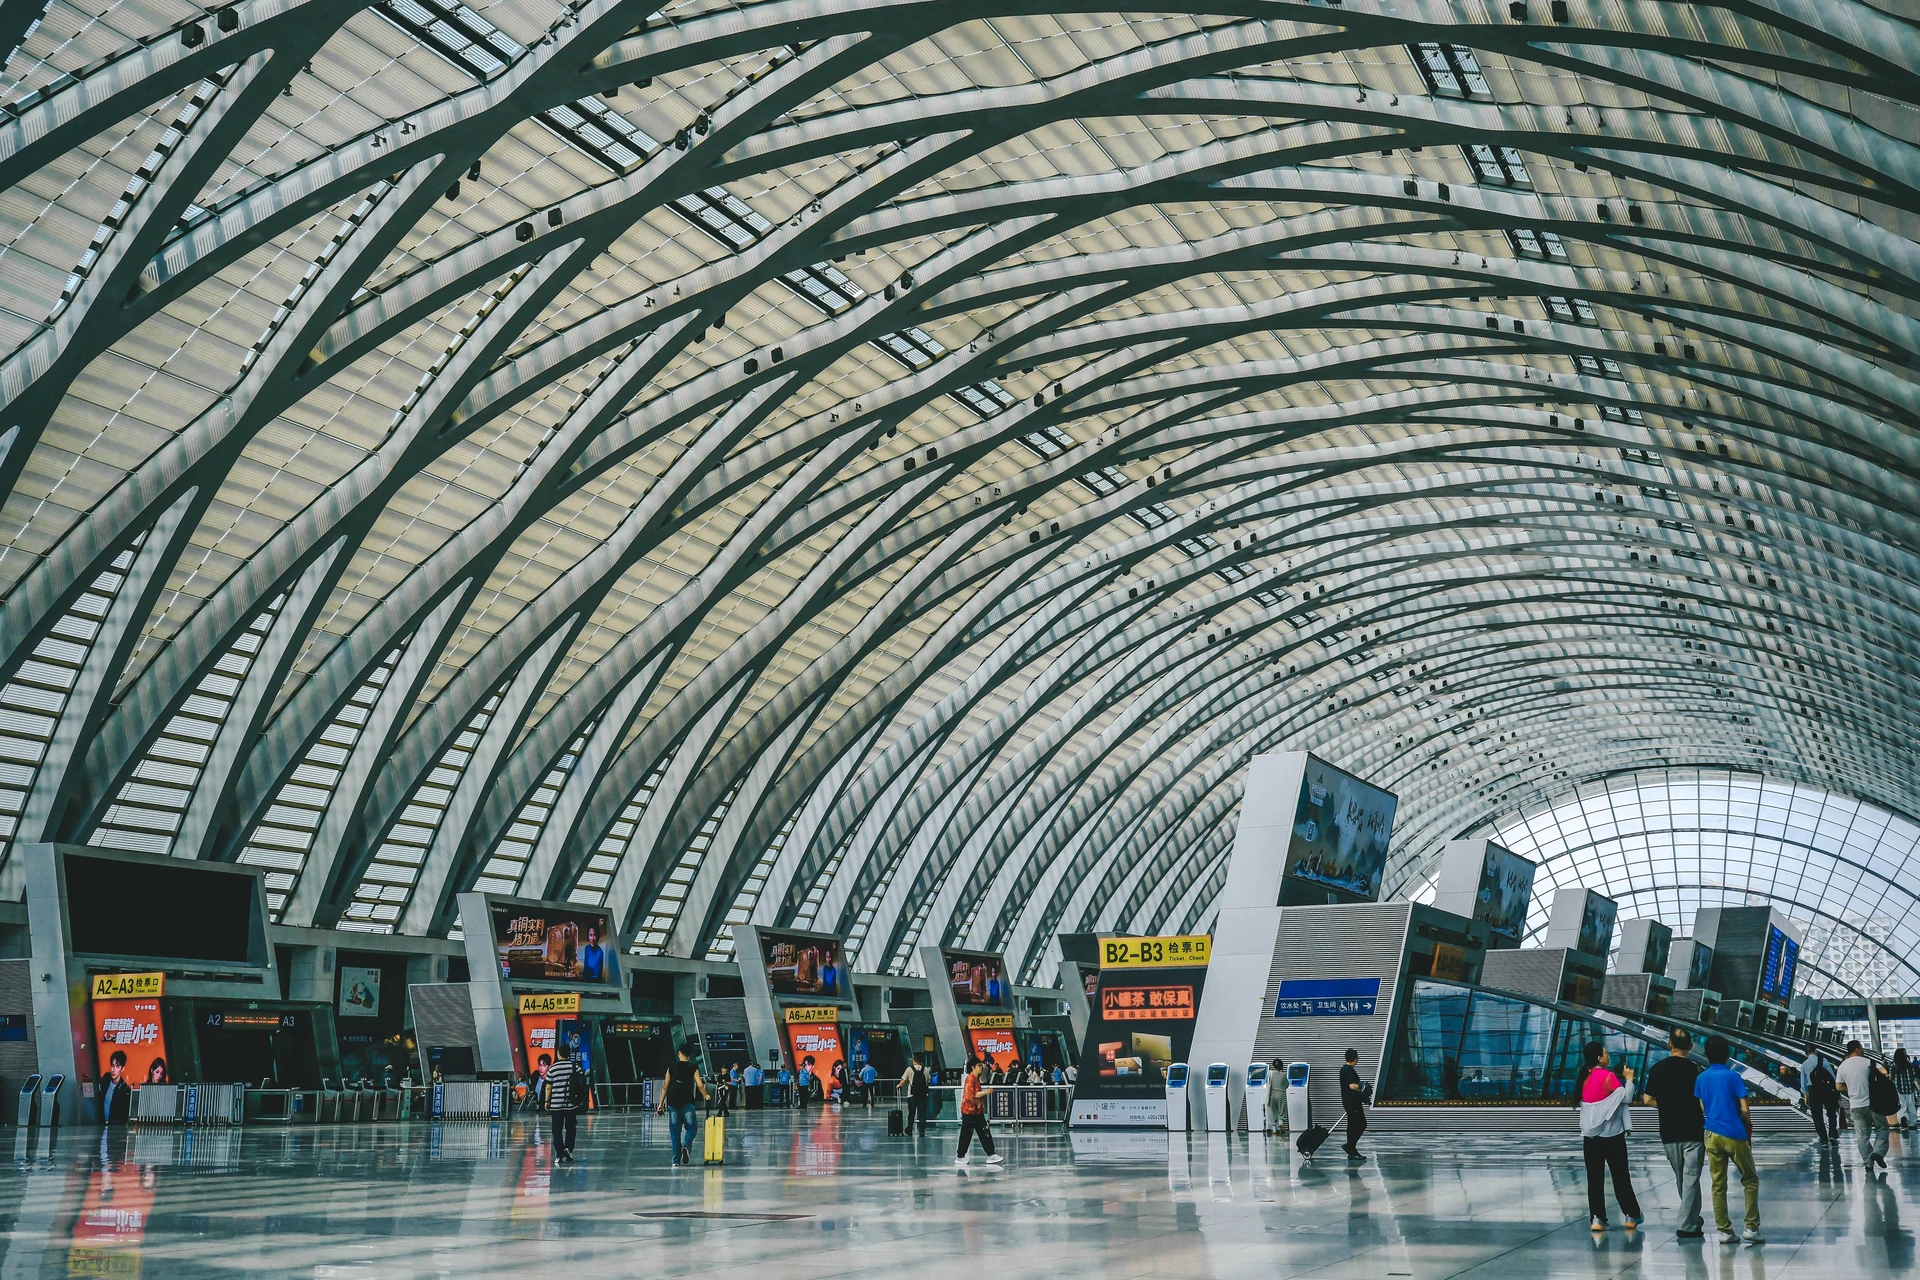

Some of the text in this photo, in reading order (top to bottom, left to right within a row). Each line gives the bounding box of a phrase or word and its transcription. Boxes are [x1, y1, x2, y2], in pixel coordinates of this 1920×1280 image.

[1106, 942, 1163, 963] B2-B3
[1169, 941, 1205, 954] 检票口
[96, 978, 134, 995] A2-A3
[136, 978, 159, 988] 检票口
[523, 998, 555, 1011] A4-A5
[1105, 990, 1190, 1008] 小罐茶 敢保真
[788, 1010, 816, 1021] A6-A7
[1107, 1009, 1190, 1019] 产品由公证处公证
[103, 1018, 135, 1032] 高端智能
[207, 1014, 221, 1026] A2
[282, 1016, 295, 1027] A3
[970, 1018, 995, 1027] A8-A9
[606, 1025, 615, 1034] A4
[651, 1026, 660, 1035] A5
